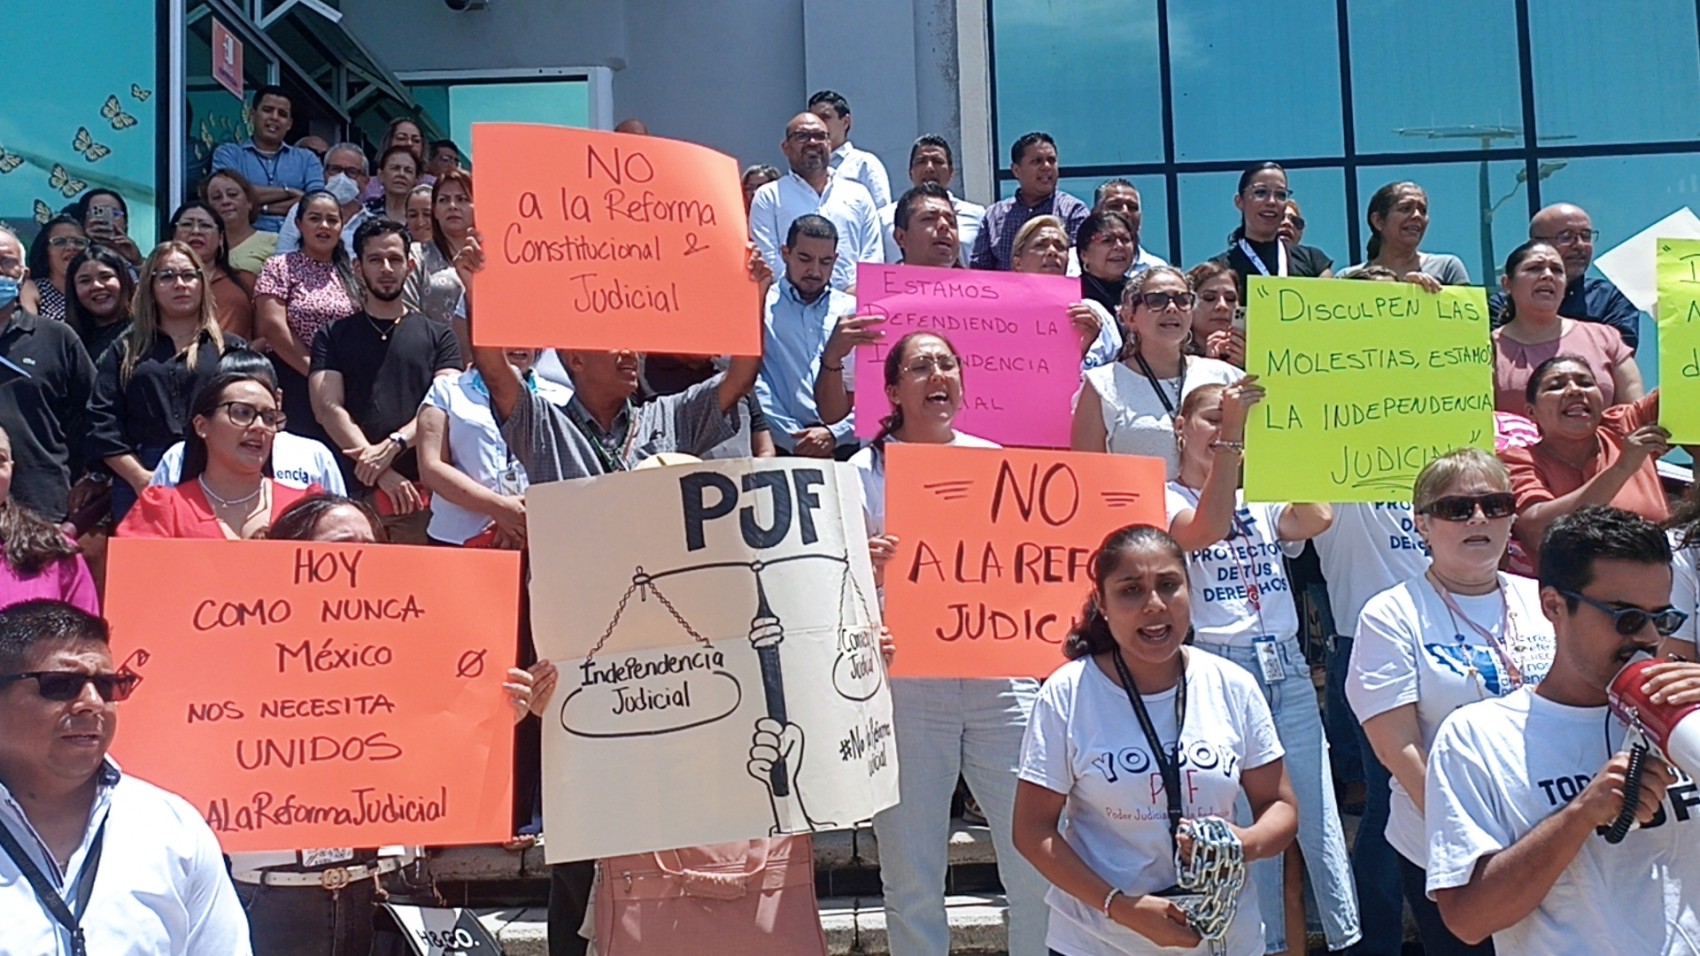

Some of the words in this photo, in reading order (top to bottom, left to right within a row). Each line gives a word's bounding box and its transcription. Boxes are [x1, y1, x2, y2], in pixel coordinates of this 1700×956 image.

[587, 144, 655, 185] NO
[518, 191, 544, 221] a
[561, 186, 592, 223] la
[604, 188, 717, 227] Reforma
[503, 221, 661, 265] Constitucional
[683, 232, 710, 256] &
[569, 272, 680, 314] Judicial
[883, 270, 1000, 300] ESTAMOS
[863, 303, 1020, 334] DEFENDIENDO
[1035, 320, 1059, 336] LA
[1436, 300, 1481, 322] LAS
[867, 342, 1050, 374] INDENCIA
[1267, 348, 1420, 377] MOLESTIAS,
[1428, 344, 1493, 369] ESTAMOS
[1266, 404, 1303, 430] LA
[1323, 393, 1493, 431] INDEPENDENCIA
[276, 468, 309, 484] encia
[990, 458, 1080, 527] NO
[679, 468, 825, 553] PJF
[293, 547, 363, 588] HOY
[907, 539, 946, 584] A
[954, 539, 1004, 584] LA
[1013, 541, 1100, 585] REFO
[1217, 566, 1239, 582] DE
[1243, 562, 1273, 579] TUS
[1202, 577, 1289, 603] DEREHOS
[192, 598, 292, 631] COMO
[320, 594, 425, 623] NUNCA
[935, 602, 1078, 644] JUDIC
[275, 638, 393, 674] México
[187, 701, 244, 724] NOS
[260, 696, 395, 719] NECESITA
[612, 681, 691, 715] Judicial
[236, 732, 402, 770] UNIDOS
[1092, 747, 1150, 783] YO
[1150, 769, 1199, 805] PF
[1537, 772, 1598, 806] TOD
[1134, 806, 1170, 821] Judicia
